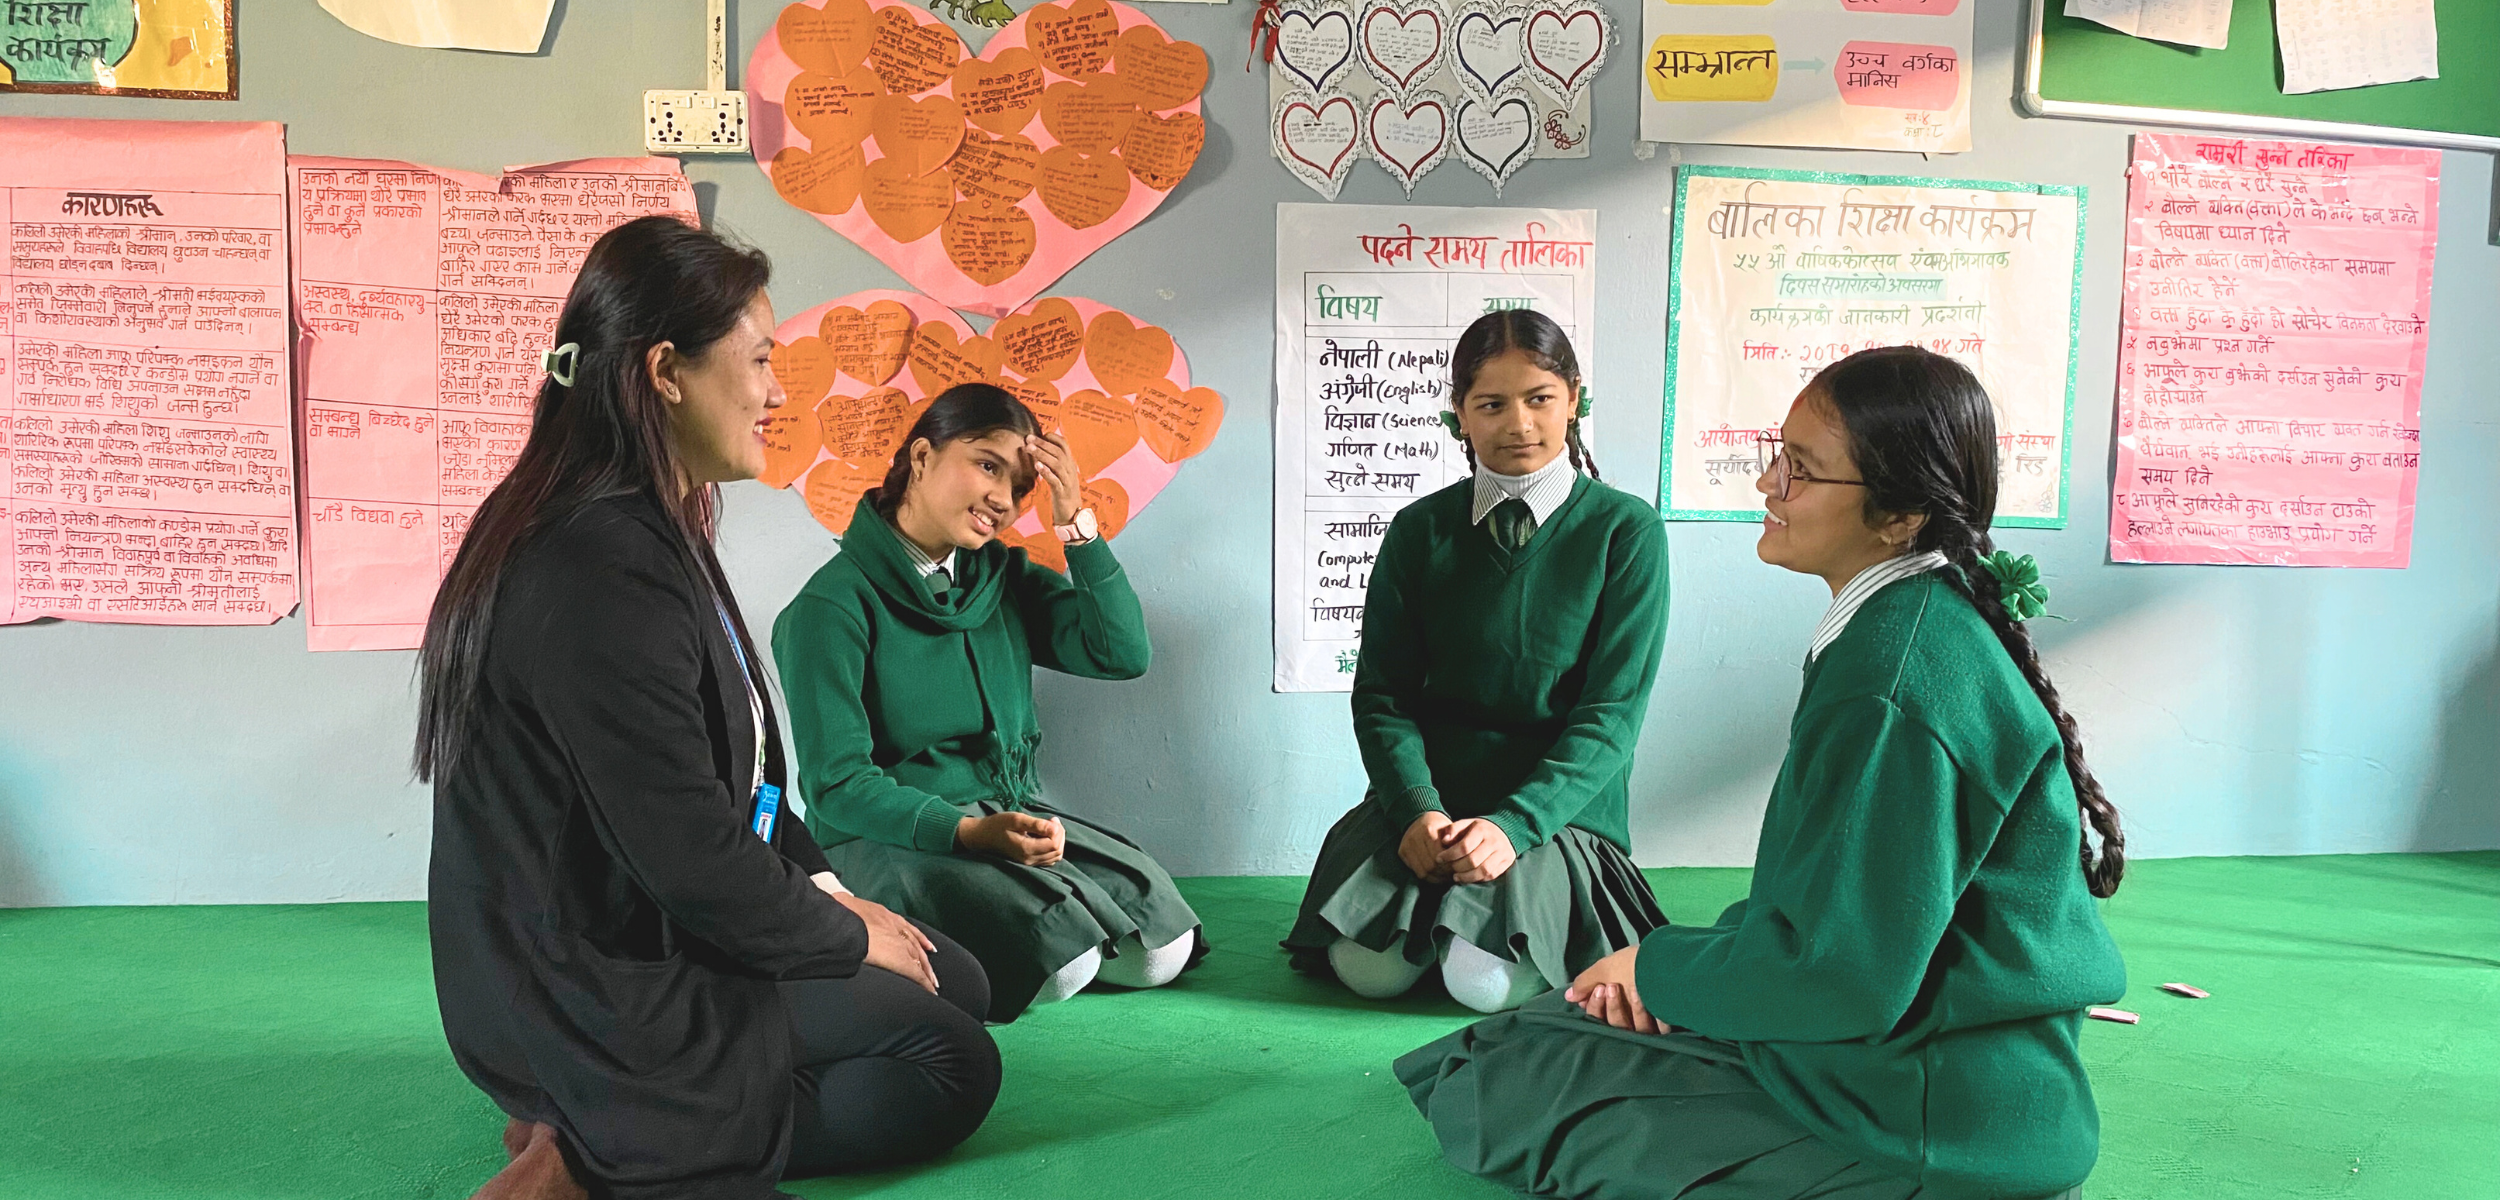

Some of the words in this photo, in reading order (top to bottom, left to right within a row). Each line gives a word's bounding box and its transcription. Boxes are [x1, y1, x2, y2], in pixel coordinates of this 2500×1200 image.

[1846, 52, 1889, 67] उच्च
[1902, 53, 1956, 72] वर्गका
[1847, 70, 1901, 88] मानिस
[62, 192, 164, 218] कारणहरू
[1708, 180, 1826, 239] बालिका
[1838, 188, 1915, 237] शिक्षा
[1920, 193, 2037, 243] कार्यक्रम
[1315, 284, 1383, 322] विषय
[1320, 339, 1383, 368] नेपाली
[1324, 405, 1381, 431] विज्ञान
[1325, 437, 1378, 459] गणित
[1371, 473, 1420, 493] समय
[1324, 513, 1393, 542] सामाजि
[1320, 574, 1353, 588] and
